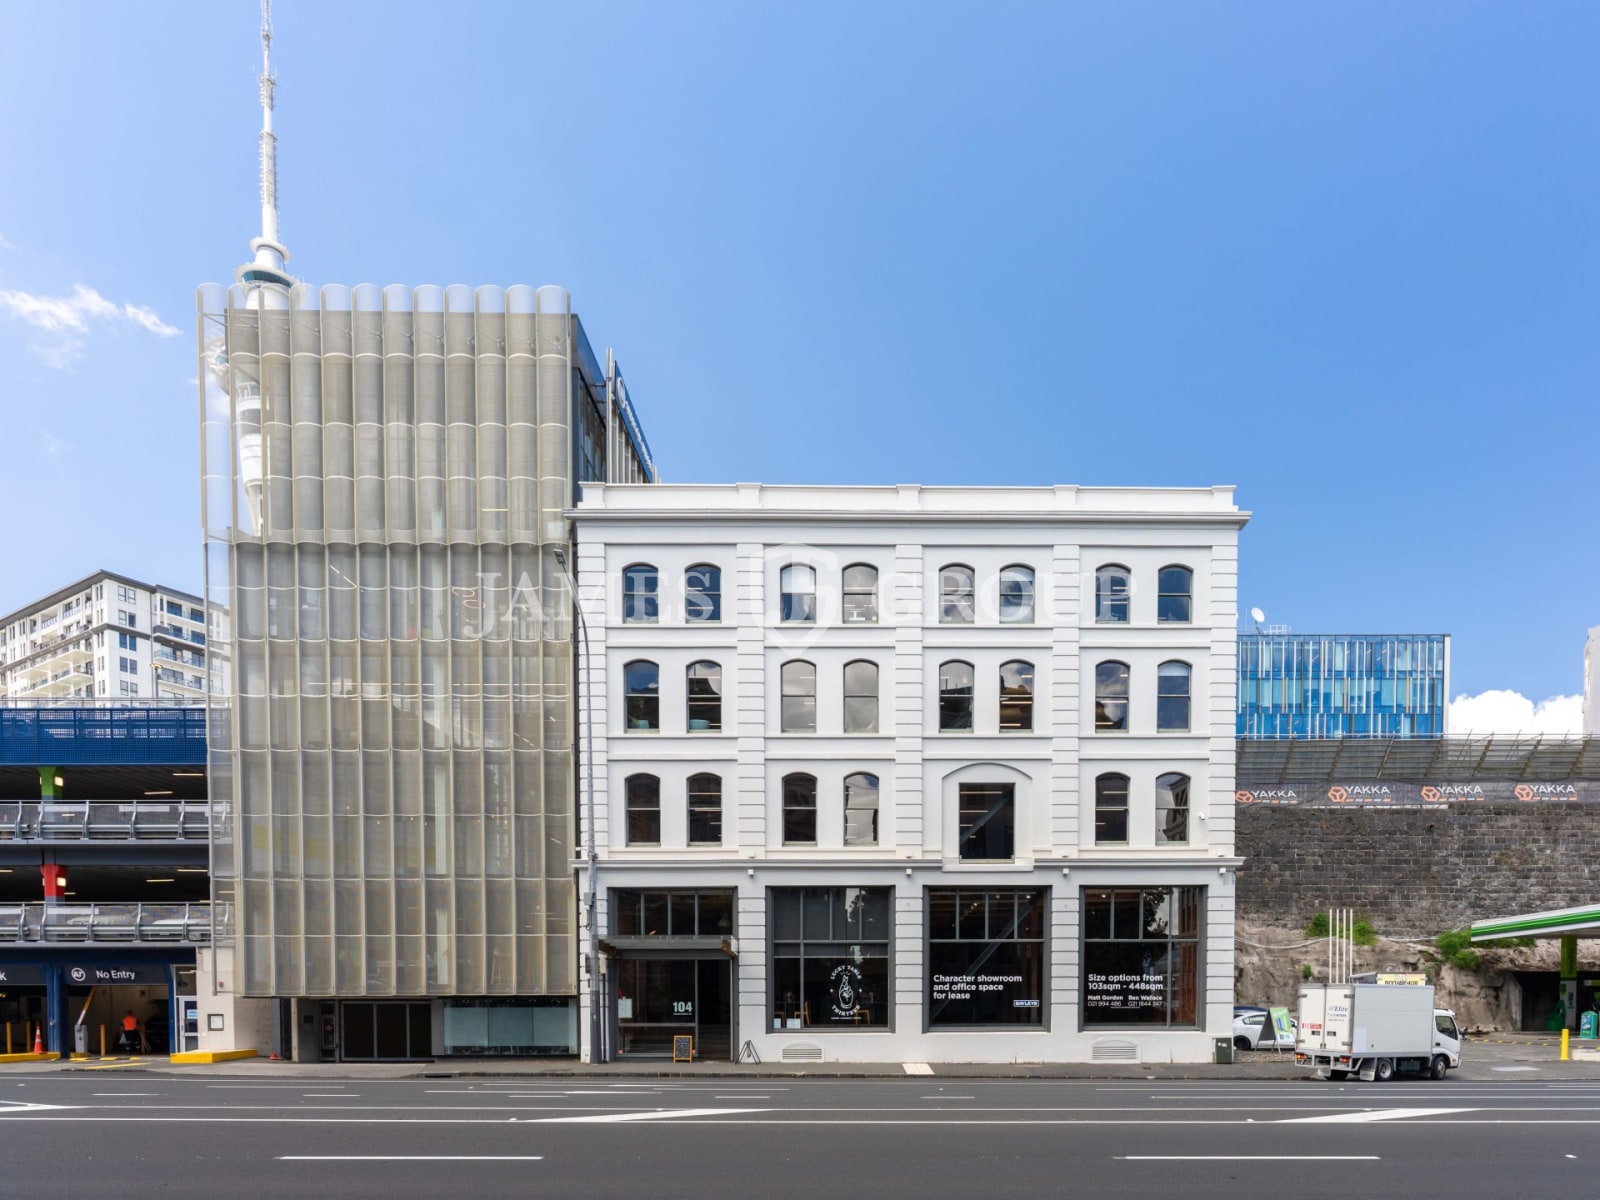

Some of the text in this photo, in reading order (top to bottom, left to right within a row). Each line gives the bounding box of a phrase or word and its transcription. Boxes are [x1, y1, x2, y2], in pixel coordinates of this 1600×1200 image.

[1345, 785, 1391, 794] YAKKA
[1437, 785, 1483, 794] YAKKA
[1531, 784, 1576, 793] YAKKA
[1250, 790, 1296, 798] YAKKA
[96, 970, 110, 979] No
[111, 970, 136, 980] Entry
[933, 974, 1022, 982] Character showroom
[1088, 973, 1163, 983] Size options from
[933, 982, 1004, 992] and office space
[1088, 982, 1121, 991] 103sqm
[1128, 982, 1164, 991] 448sqm
[948, 991, 971, 999] lease
[673, 1001, 693, 1013] 104
